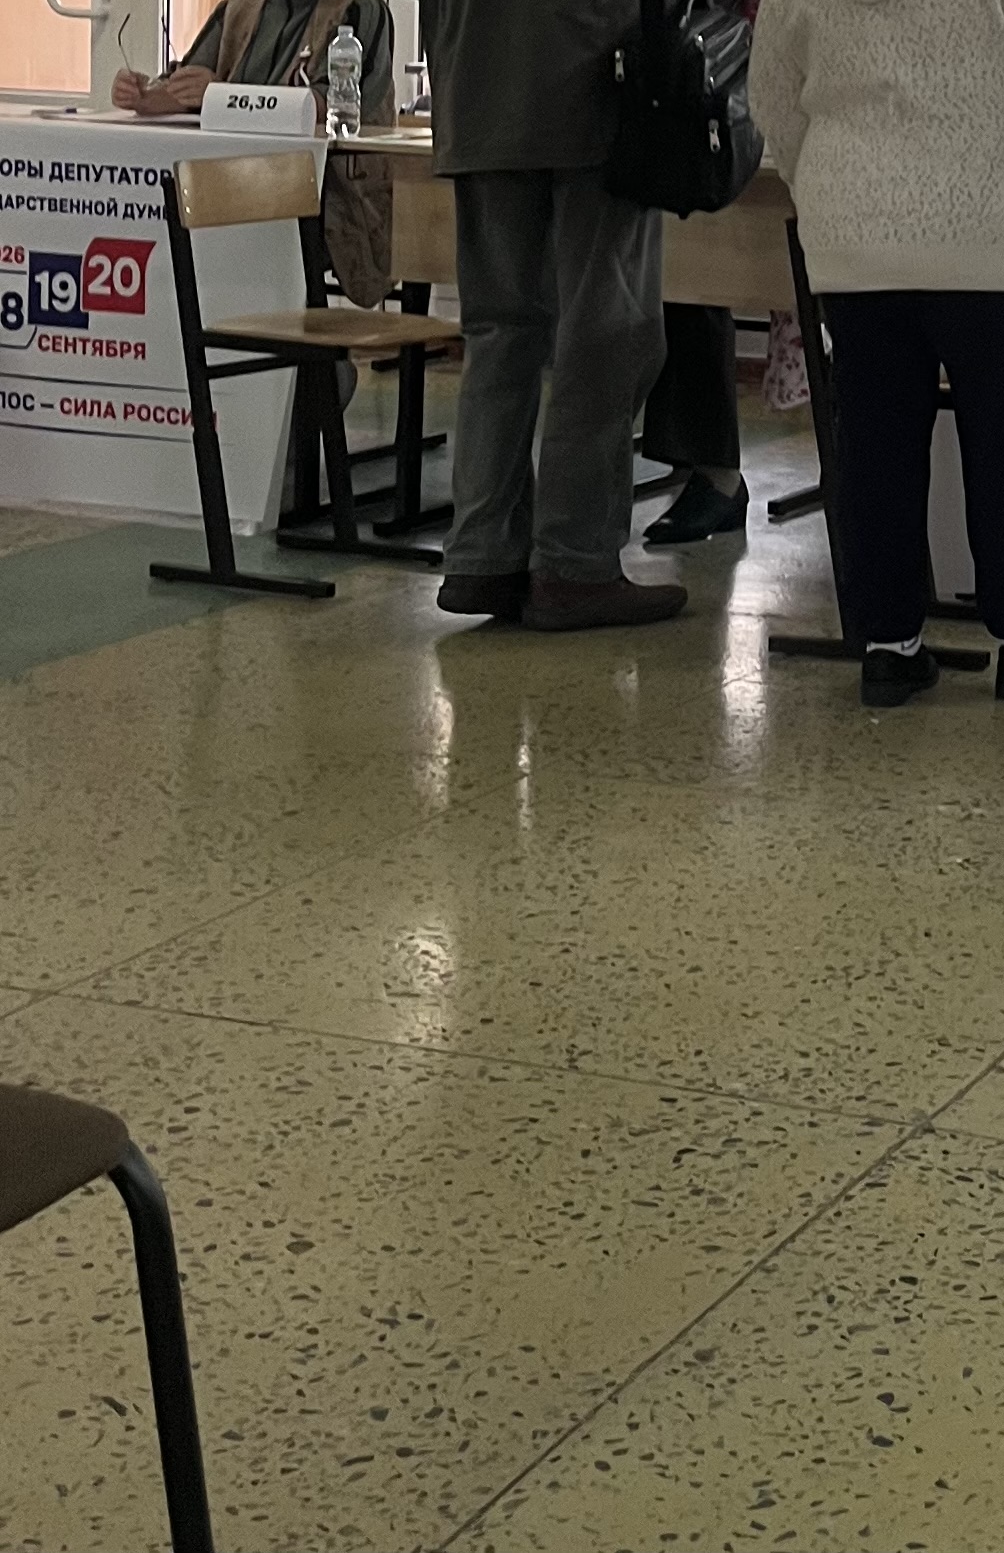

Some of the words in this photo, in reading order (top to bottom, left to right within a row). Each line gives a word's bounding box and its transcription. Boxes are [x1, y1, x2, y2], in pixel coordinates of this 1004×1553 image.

[227, 95, 278, 112] 26,30
[0, 158, 43, 179] ОРЫ
[0, 193, 118, 218] АРСТВЕННОЙ
[122, 202, 168, 221] ДУМ
[0, 246, 25, 265] 26
[0, 291, 24, 331] 8
[34, 270, 78, 313] 19
[87, 254, 141, 297] 20
[37, 333, 147, 361] СЕНТЯБРЯ
[59, 397, 117, 420] СИЛА
[123, 401, 217, 432] РОССИ
